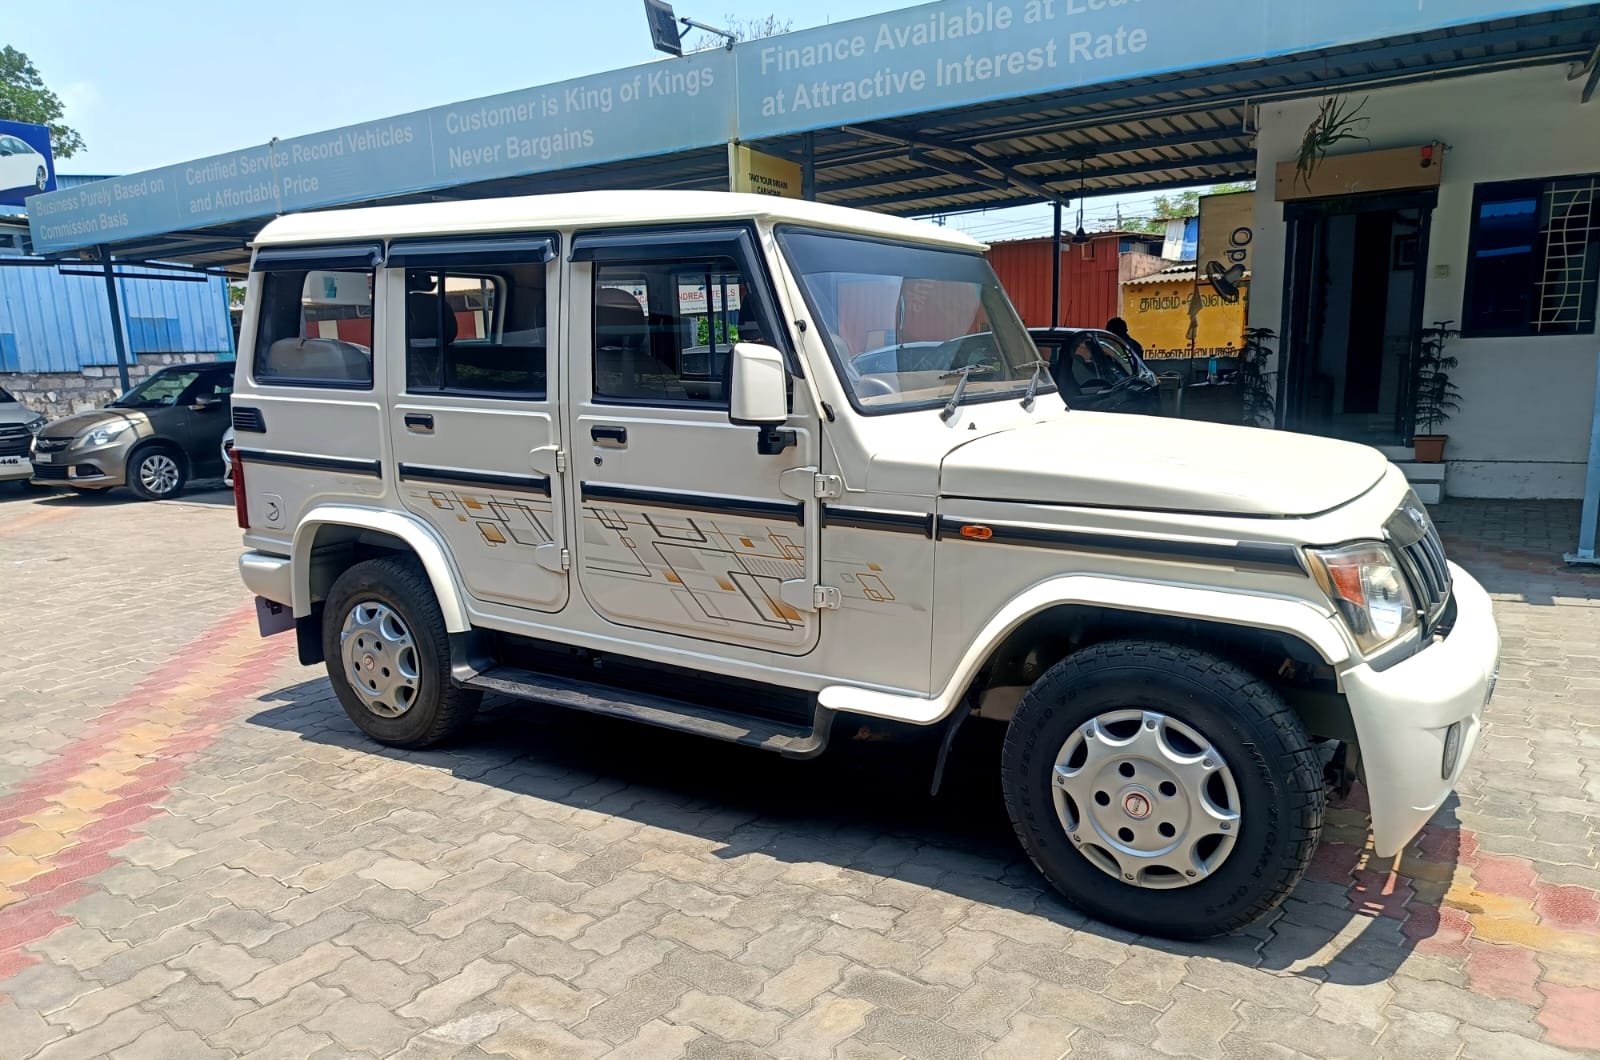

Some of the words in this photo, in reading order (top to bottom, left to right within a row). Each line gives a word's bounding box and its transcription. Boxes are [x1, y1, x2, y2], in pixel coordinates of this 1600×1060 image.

[761, 34, 866, 75] Finance
[873, 0, 1013, 53] Available
[1023, 0, 1055, 25] at
[761, 90, 785, 118] at
[791, 65, 927, 112] Attractive
[936, 39, 1057, 88] Interest
[1068, 27, 1148, 65] Rate
[446, 99, 536, 135] Customer
[541, 94, 558, 118] is
[565, 86, 613, 113] King
[620, 74, 643, 103] of
[647, 64, 714, 98] Kings
[185, 159, 238, 187] Certified
[240, 150, 289, 175] Service
[292, 135, 344, 164] Record
[348, 124, 413, 153] Vehicles
[449, 139, 503, 169] Never
[506, 127, 594, 161] Bargains
[36, 196, 79, 217] Business
[80, 190, 112, 211] Purely
[114, 180, 148, 200] Based
[150, 179, 165, 194] on
[189, 193, 212, 214] and
[214, 182, 280, 209] Affordable
[283, 173, 319, 196] Price
[760, 175, 772, 186] YOUR
[39, 219, 98, 241] Commission
[100, 211, 128, 231] Basis
